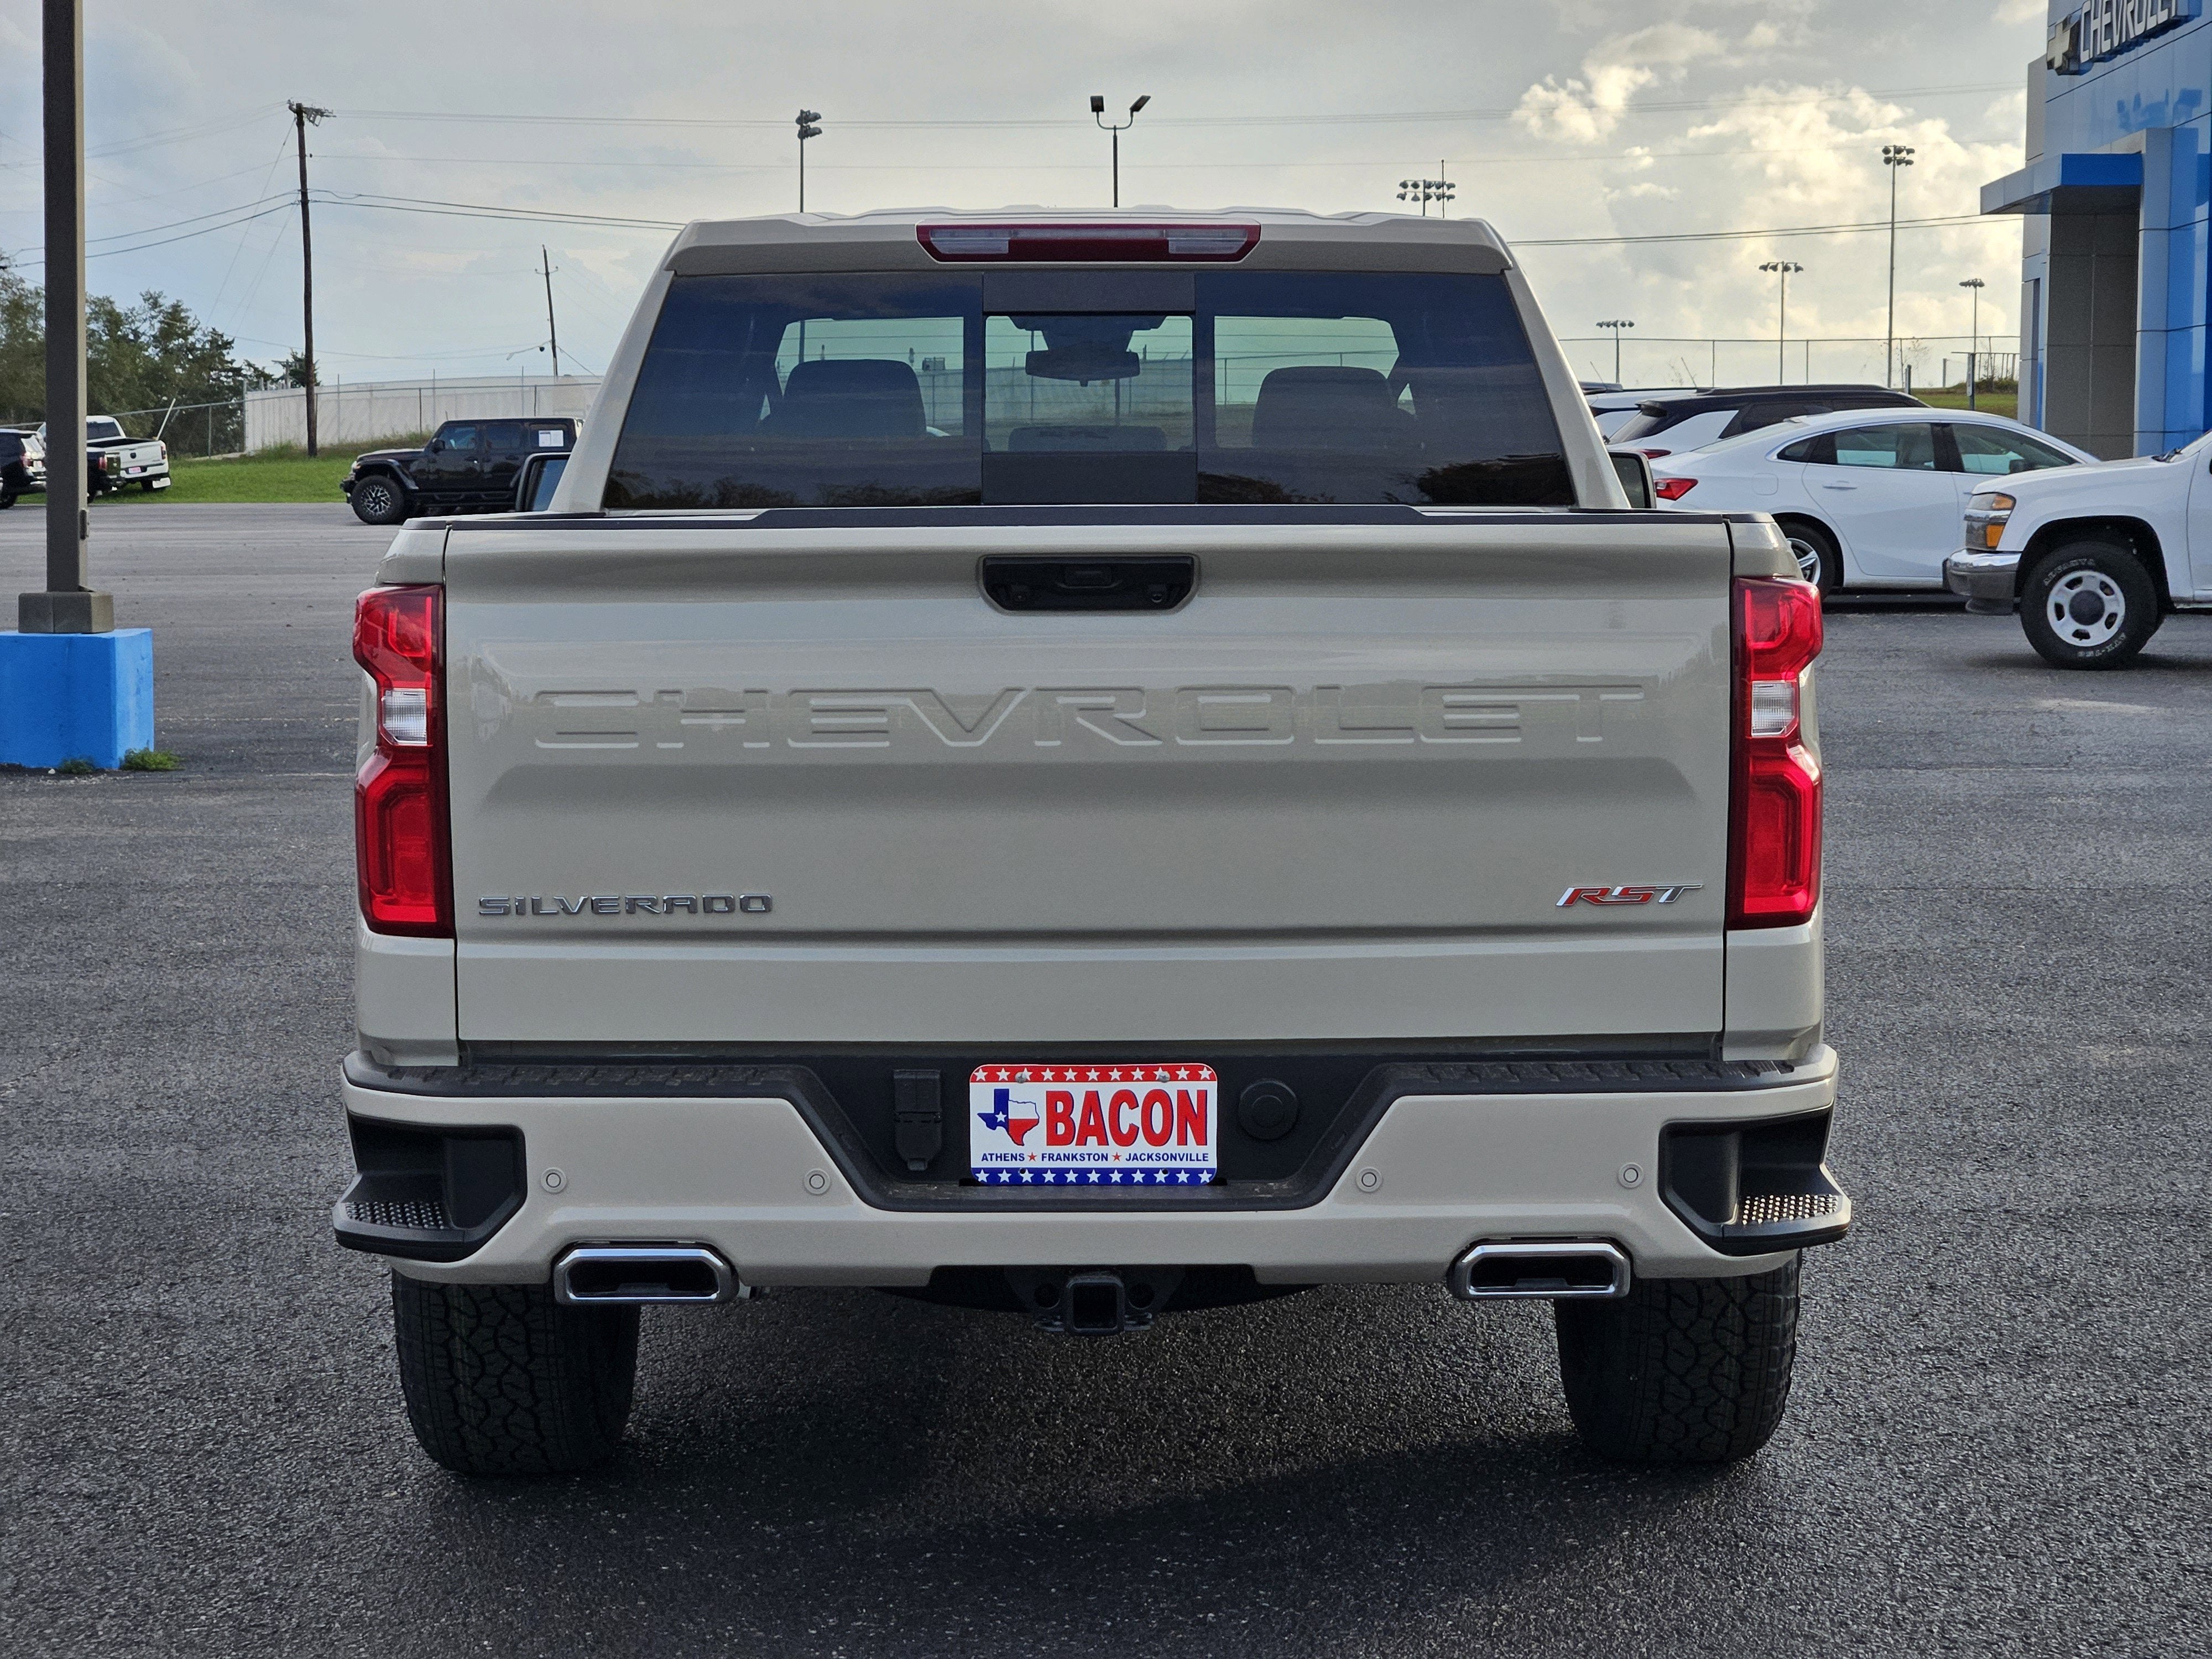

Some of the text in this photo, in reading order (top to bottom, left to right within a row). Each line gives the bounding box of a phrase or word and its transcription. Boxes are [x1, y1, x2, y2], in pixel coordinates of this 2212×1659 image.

[534, 684, 1645, 749] CHEVROLET
[478, 893, 773, 915] SILVERADO
[1555, 883, 1703, 906] RST
[1045, 1089, 1208, 1147] BACON
[980, 1152, 1209, 1162] ATHENS FRANKSTON JACKSONVILLE
